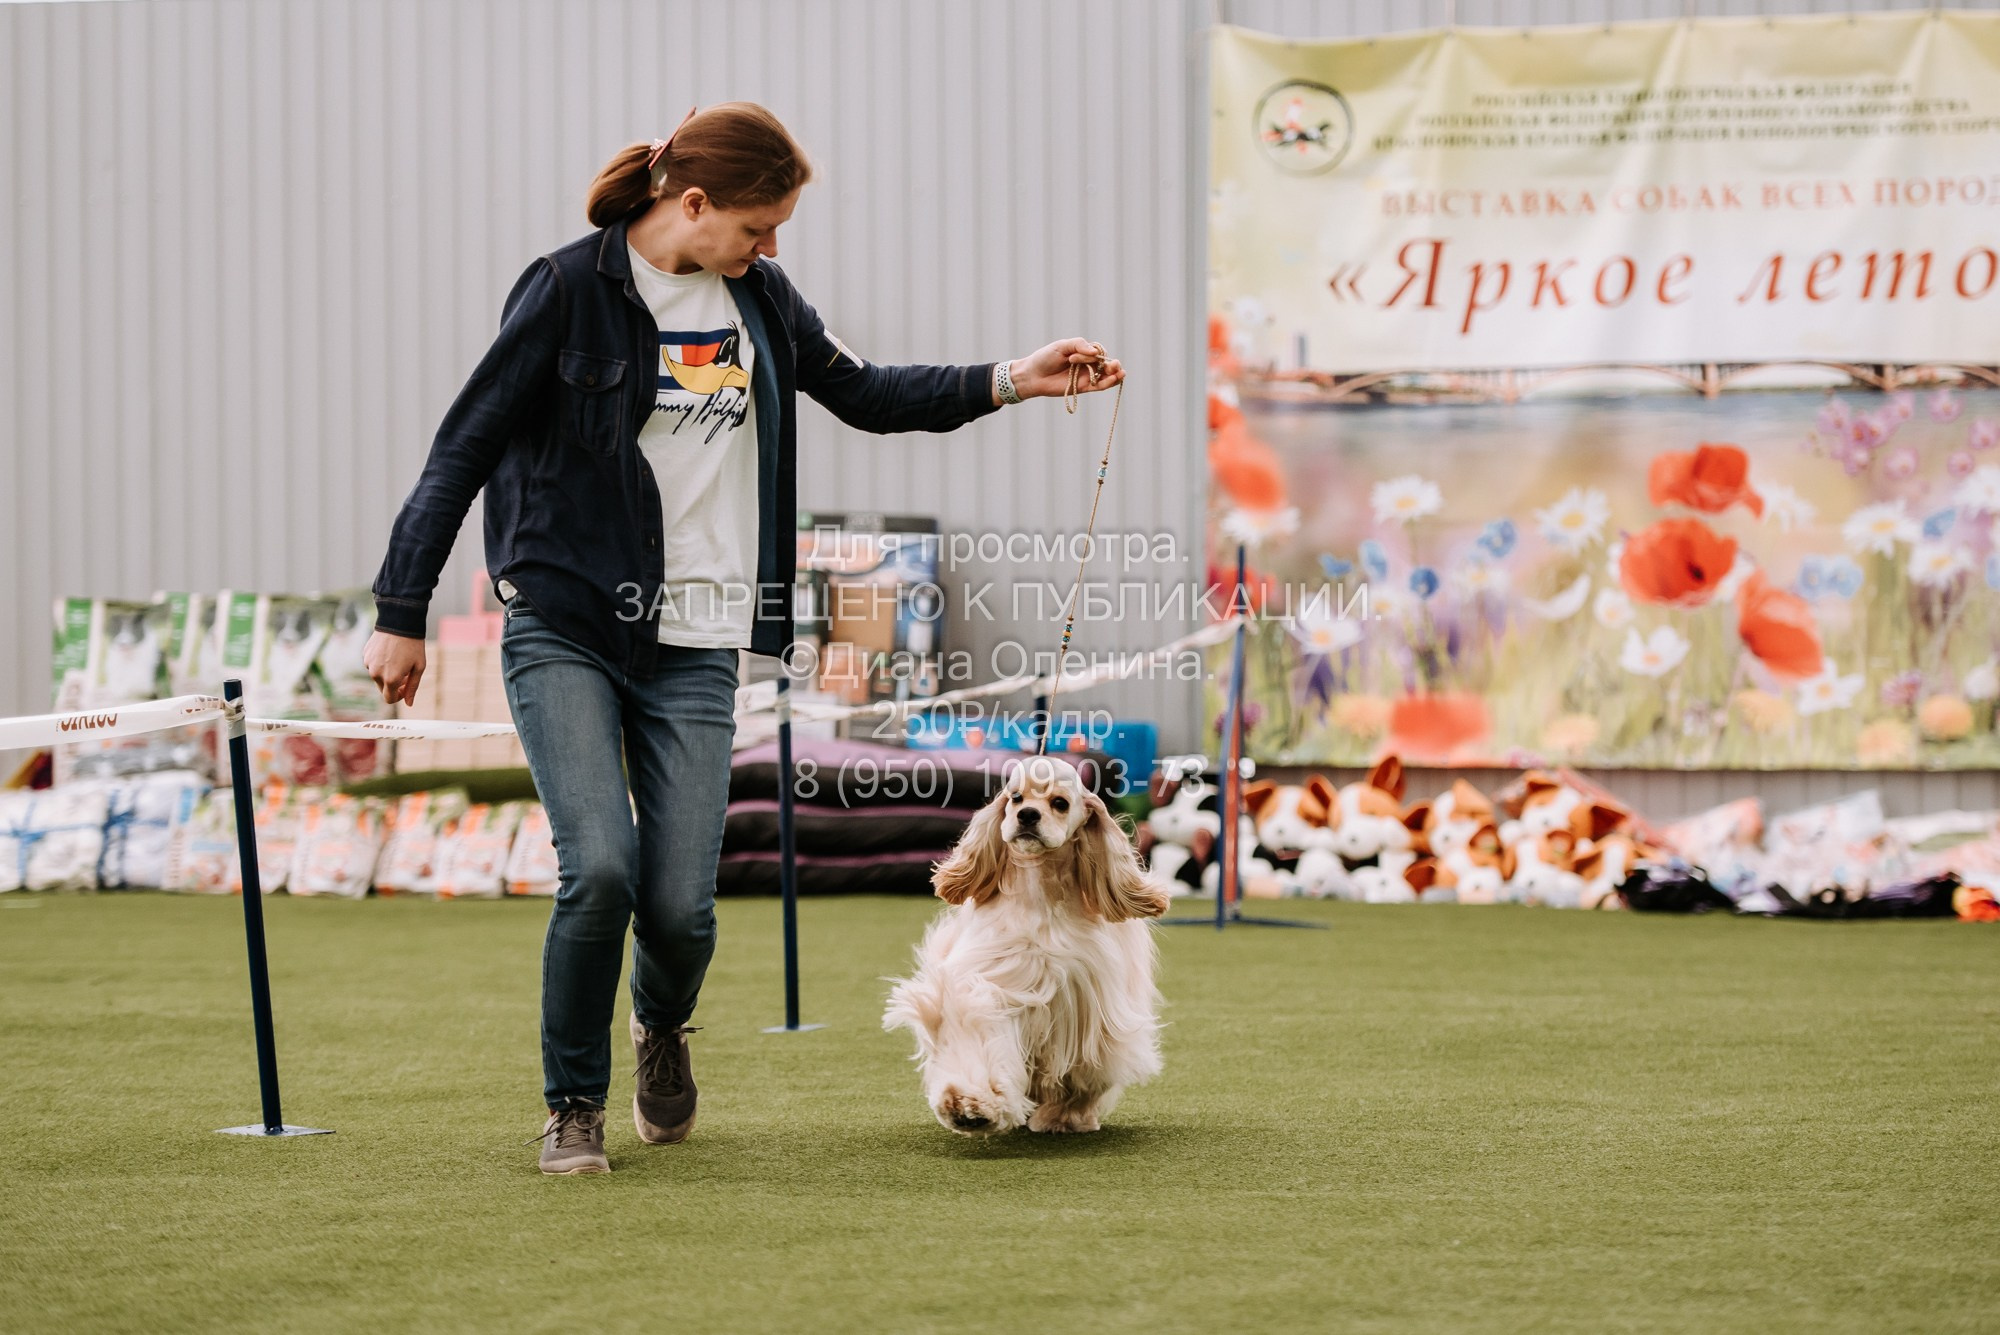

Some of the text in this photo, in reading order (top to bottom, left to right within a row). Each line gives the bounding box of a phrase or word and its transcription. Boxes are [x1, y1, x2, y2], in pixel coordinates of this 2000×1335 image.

[1381, 188, 1597, 217] ВЫСТАВКА
[1609, 181, 1743, 213] СОБАК
[1757, 178, 1857, 211] ВСЕХ
[1326, 235, 1999, 338] «Яркое лето
